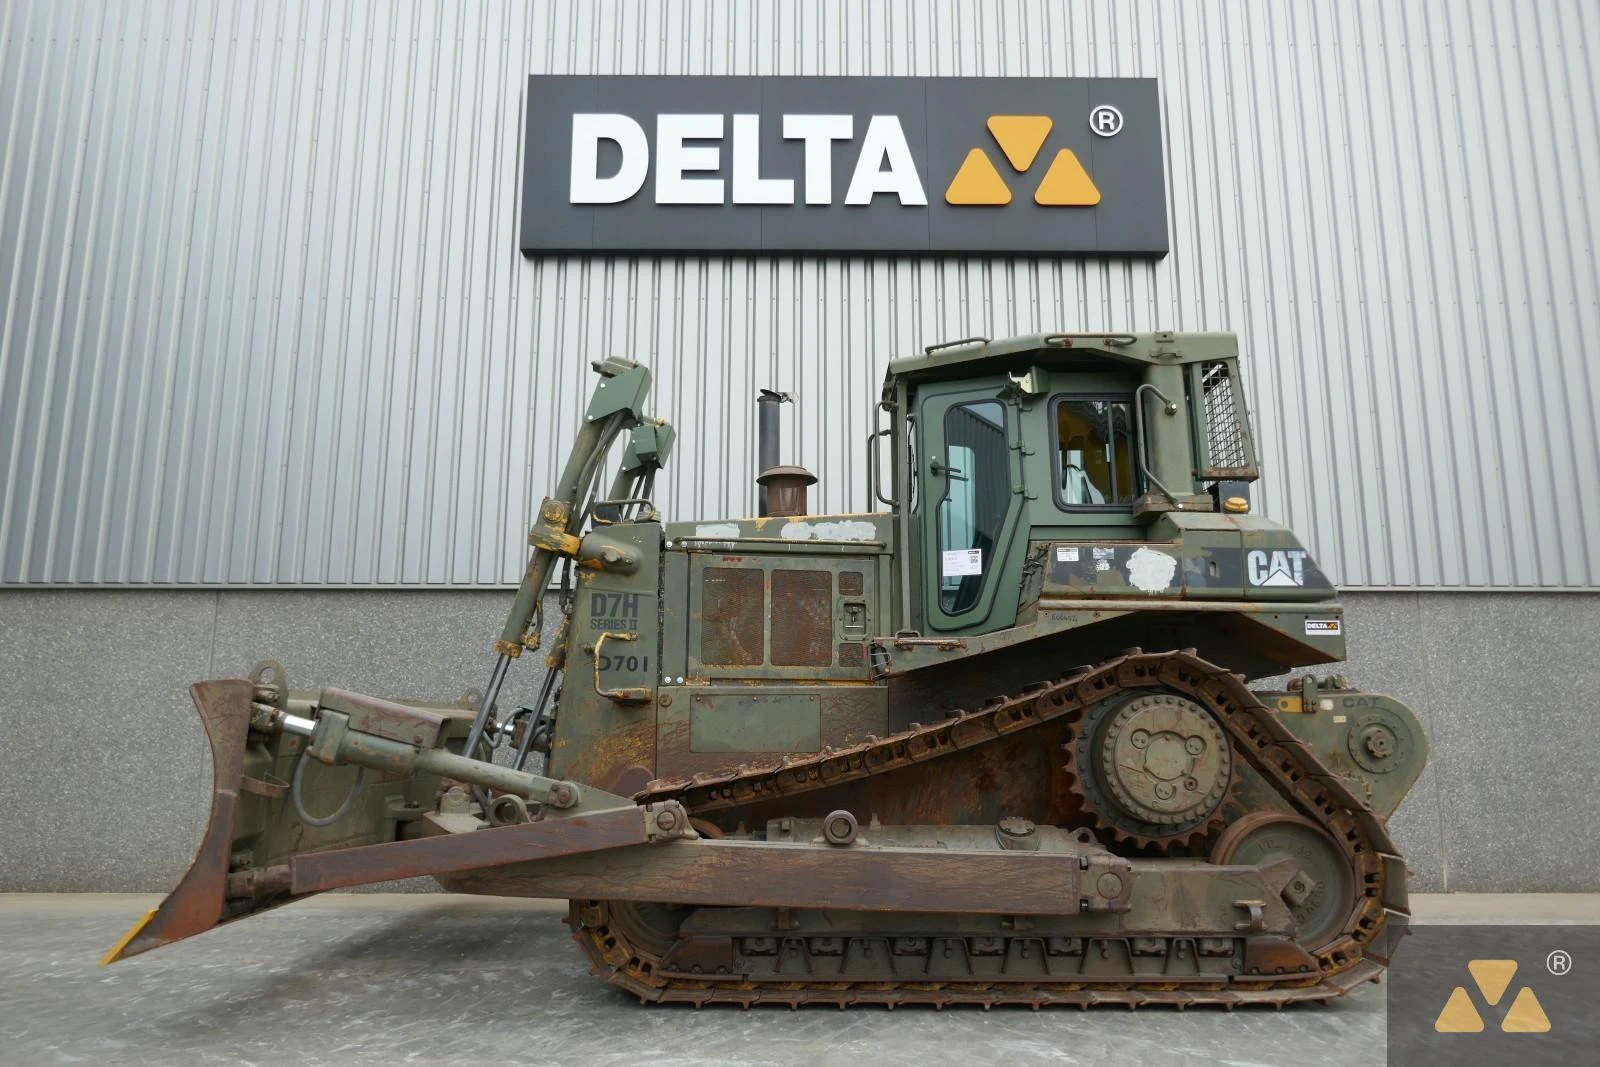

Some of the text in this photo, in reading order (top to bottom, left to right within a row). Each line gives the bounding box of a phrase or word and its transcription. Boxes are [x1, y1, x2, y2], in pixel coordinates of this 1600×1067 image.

[569, 112, 929, 206] DELTA
[1247, 550, 1307, 586] CAT
[591, 593, 639, 618] D7H
[590, 619, 627, 630] SERIES
[1343, 698, 1379, 708] CAT
